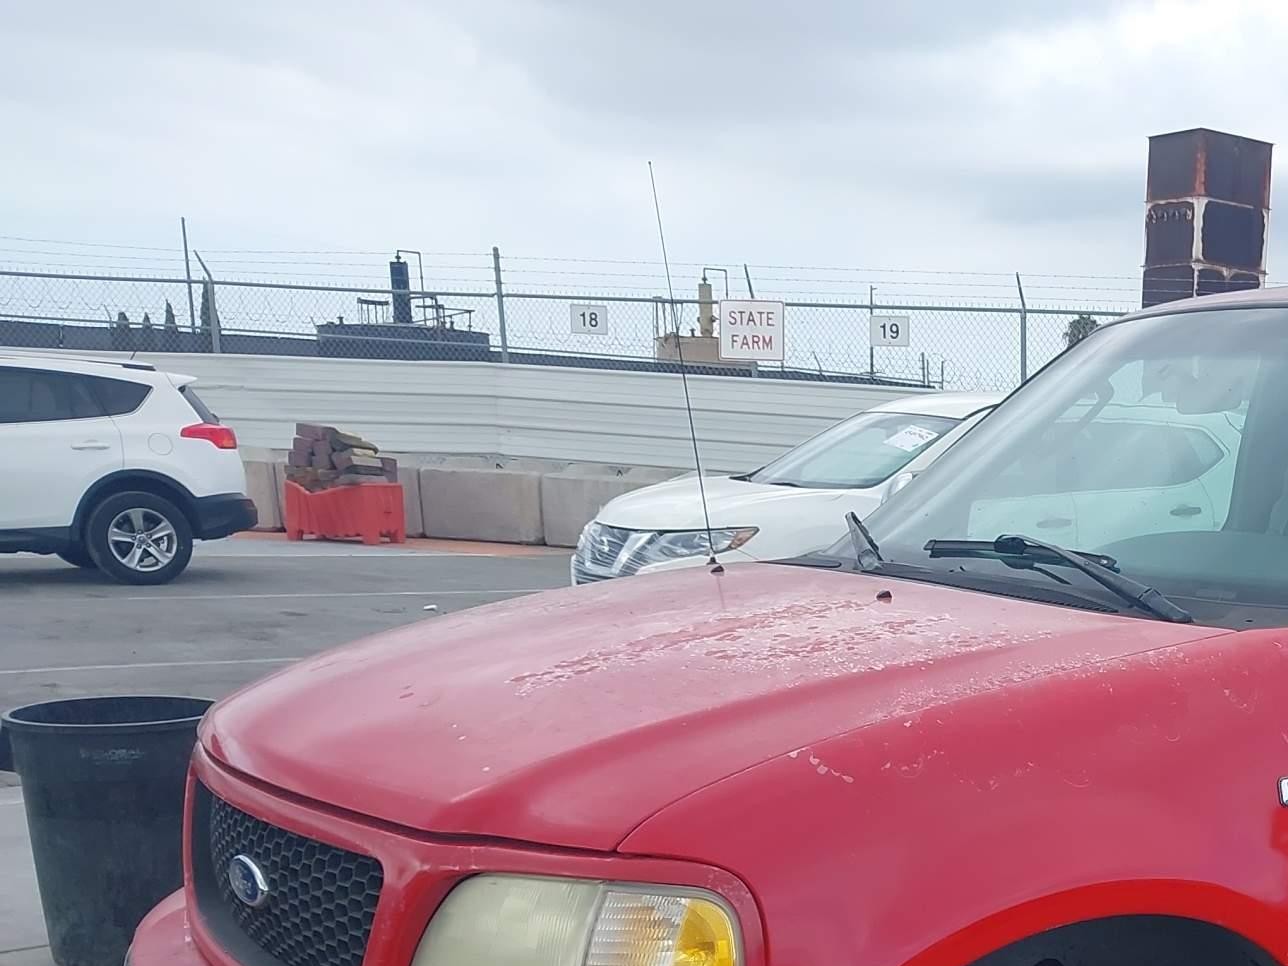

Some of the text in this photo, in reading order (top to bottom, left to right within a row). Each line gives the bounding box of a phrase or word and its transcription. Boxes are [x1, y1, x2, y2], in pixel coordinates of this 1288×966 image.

[579, 311, 598, 328] 18
[728, 310, 775, 327] STATE
[880, 322, 899, 339] 19
[731, 334, 773, 351] FARM
